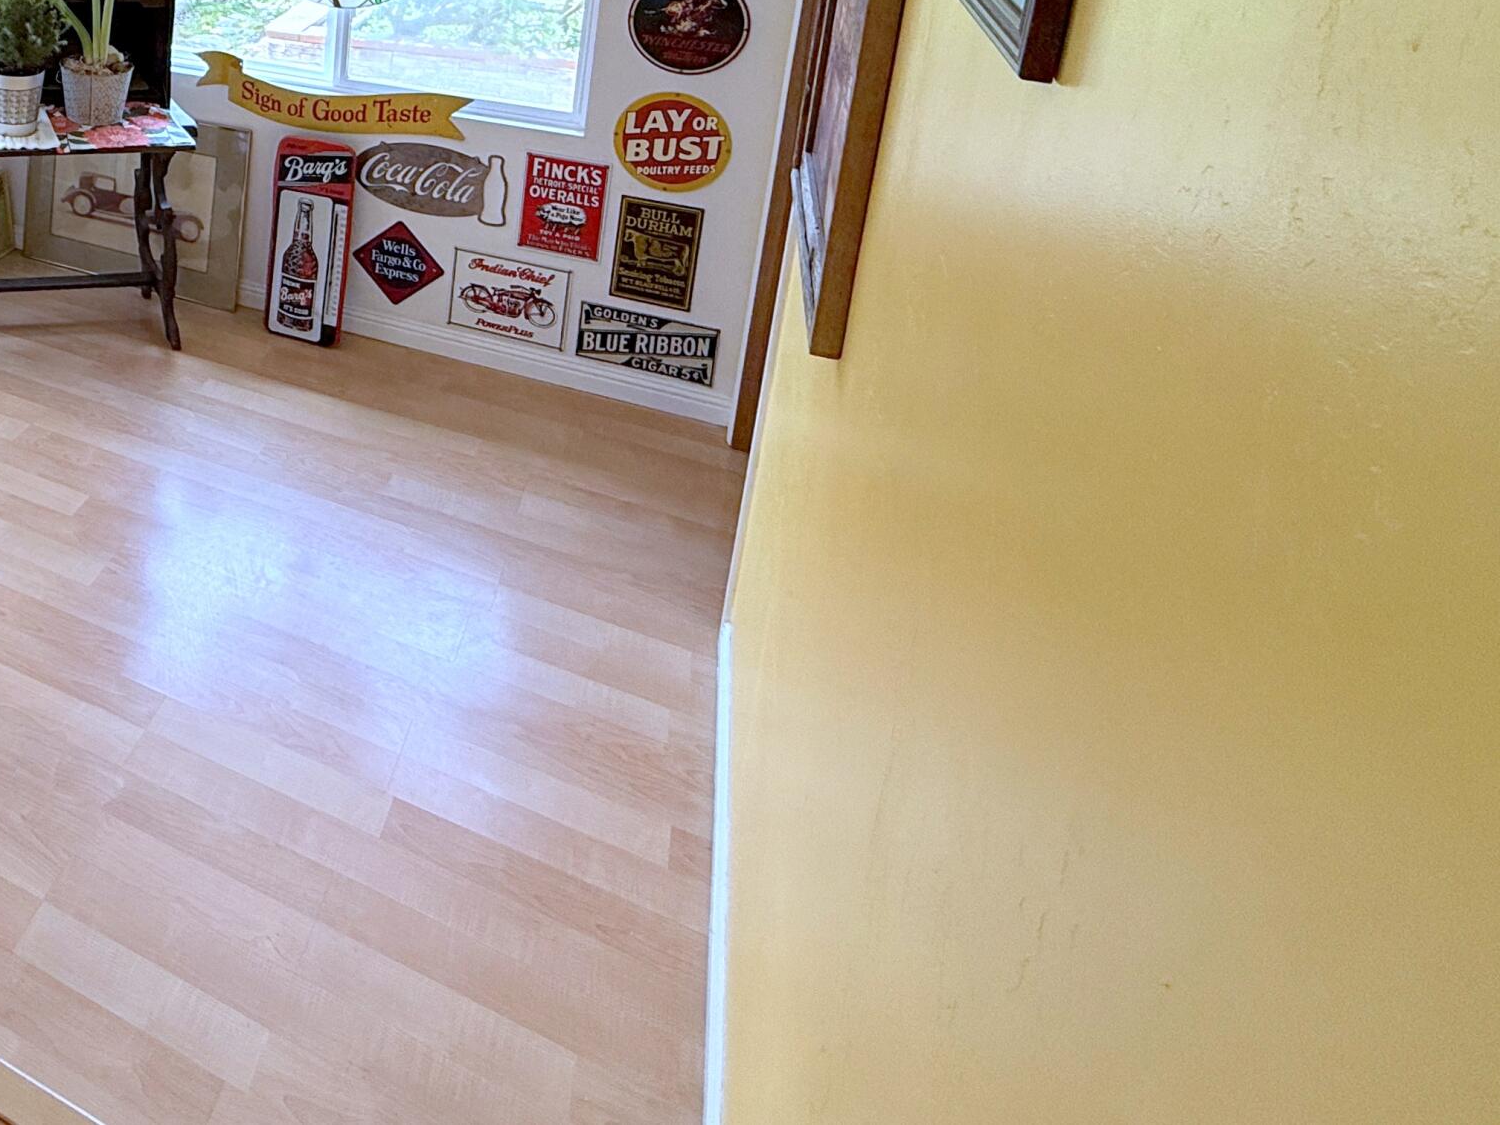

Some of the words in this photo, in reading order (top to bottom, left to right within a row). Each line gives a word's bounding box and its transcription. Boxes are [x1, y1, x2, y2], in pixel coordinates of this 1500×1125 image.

[642, 33, 732, 54] WINCHESTER
[241, 80, 282, 113] Sign
[287, 97, 309, 119] of
[312, 99, 367, 124] Good
[373, 99, 431, 124] Taste
[625, 109, 693, 134] LAY
[692, 116, 718, 132] OR
[624, 136, 726, 162] BUST
[284, 156, 348, 183] Barq's
[360, 152, 483, 204] Coca-Cola
[532, 157, 602, 187] FINCK'S
[636, 165, 681, 175] POULTRY
[683, 165, 717, 175] FEEDS
[529, 184, 600, 208] OVERALLS
[625, 215, 693, 238] DURHAM
[640, 207, 681, 224] BULL
[381, 239, 417, 257] Wells
[371, 250, 401, 267] Fargo
[401, 256, 413, 268] &
[412, 259, 426, 272] Co
[468, 258, 518, 278] Indian
[516, 266, 556, 287] Chief
[375, 263, 420, 283] Express
[280, 286, 312, 305] Barq's
[582, 332, 631, 353] BLUE
[635, 333, 710, 356] RIBBON
[631, 357, 678, 377] CIGAR
